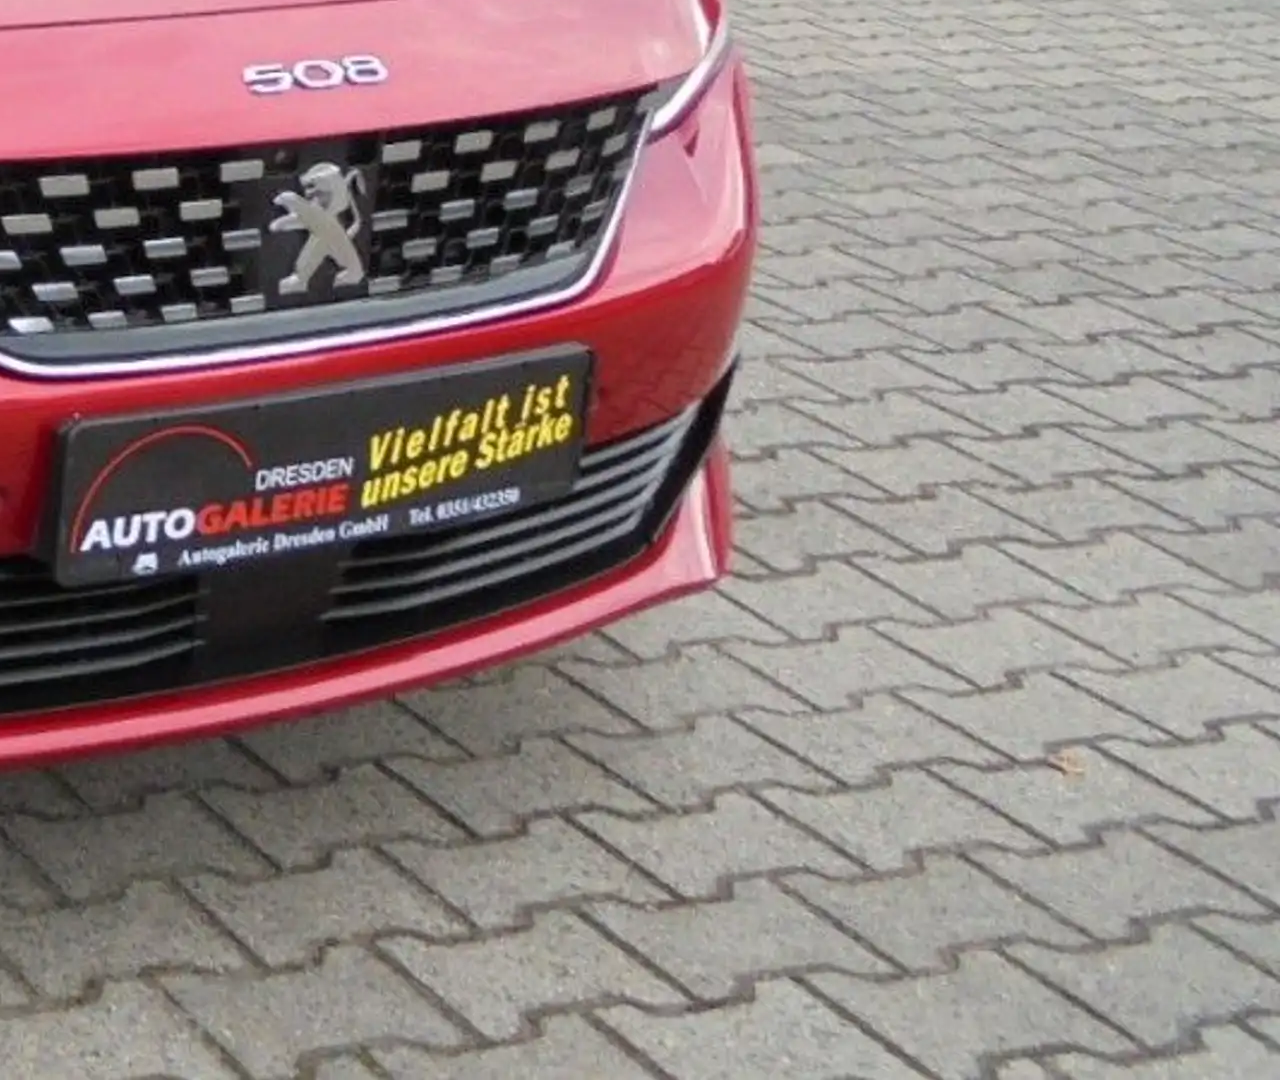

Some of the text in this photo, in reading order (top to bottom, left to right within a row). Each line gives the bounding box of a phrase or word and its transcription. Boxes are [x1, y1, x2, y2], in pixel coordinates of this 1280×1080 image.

[242, 54, 389, 95] 508
[370, 374, 570, 471] Vielfalt ist
[254, 456, 354, 492] DRESDEN
[361, 412, 573, 509] unsere Stärke
[80, 483, 350, 552] AUTOGALERIE
[177, 536, 270, 568] Autogalerie
[272, 525, 336, 551] Dresden
[339, 514, 389, 539] GmbH
